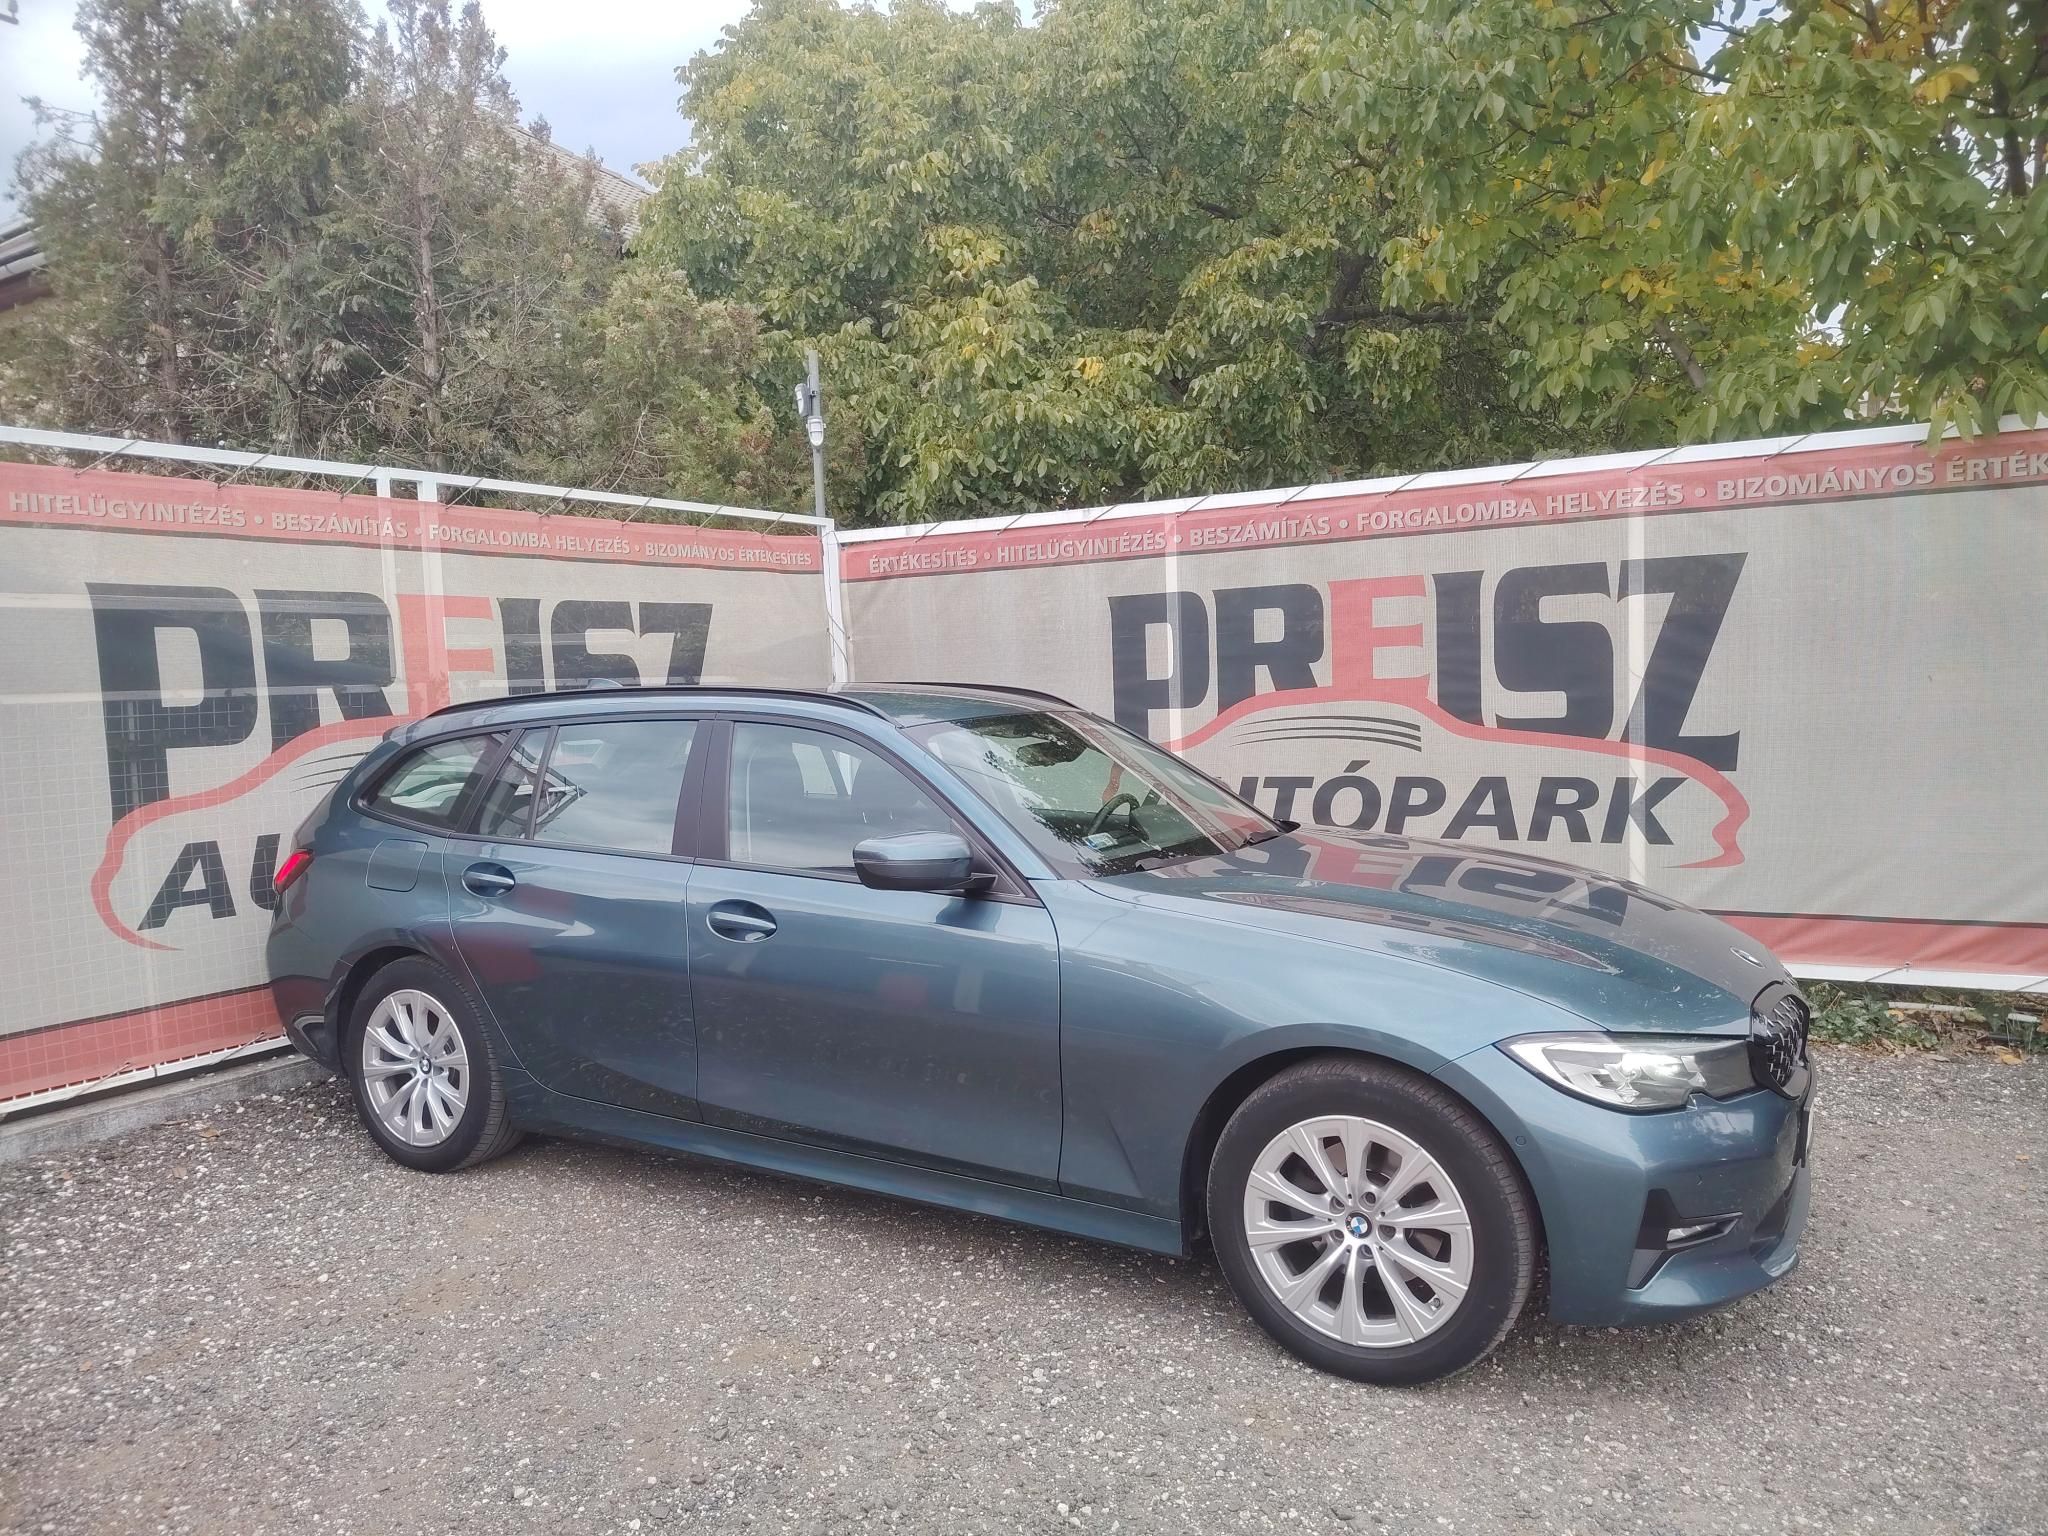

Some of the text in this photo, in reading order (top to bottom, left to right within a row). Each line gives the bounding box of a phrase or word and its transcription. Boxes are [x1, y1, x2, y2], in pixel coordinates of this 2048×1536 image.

[8, 491, 246, 527] HITELÜGYINTÉZÉS
[271, 510, 408, 538] BESZÁMÍTÁS
[555, 535, 630, 554] HELYEZÉS
[645, 542, 735, 561] BIZOMÁNYOS
[869, 548, 978, 574] ÉRTÉKESÍTÉS
[997, 530, 1167, 563] HITELÜGYINTÉZÉS
[1190, 514, 1331, 546] BESZÁMÍTÁS
[1356, 494, 1538, 531] FORGALOMBA
[1547, 483, 1684, 515] HELYEZÉS
[1717, 461, 1935, 500] BIZOMÁNYOS
[1108, 552, 1749, 771] PREISZ
